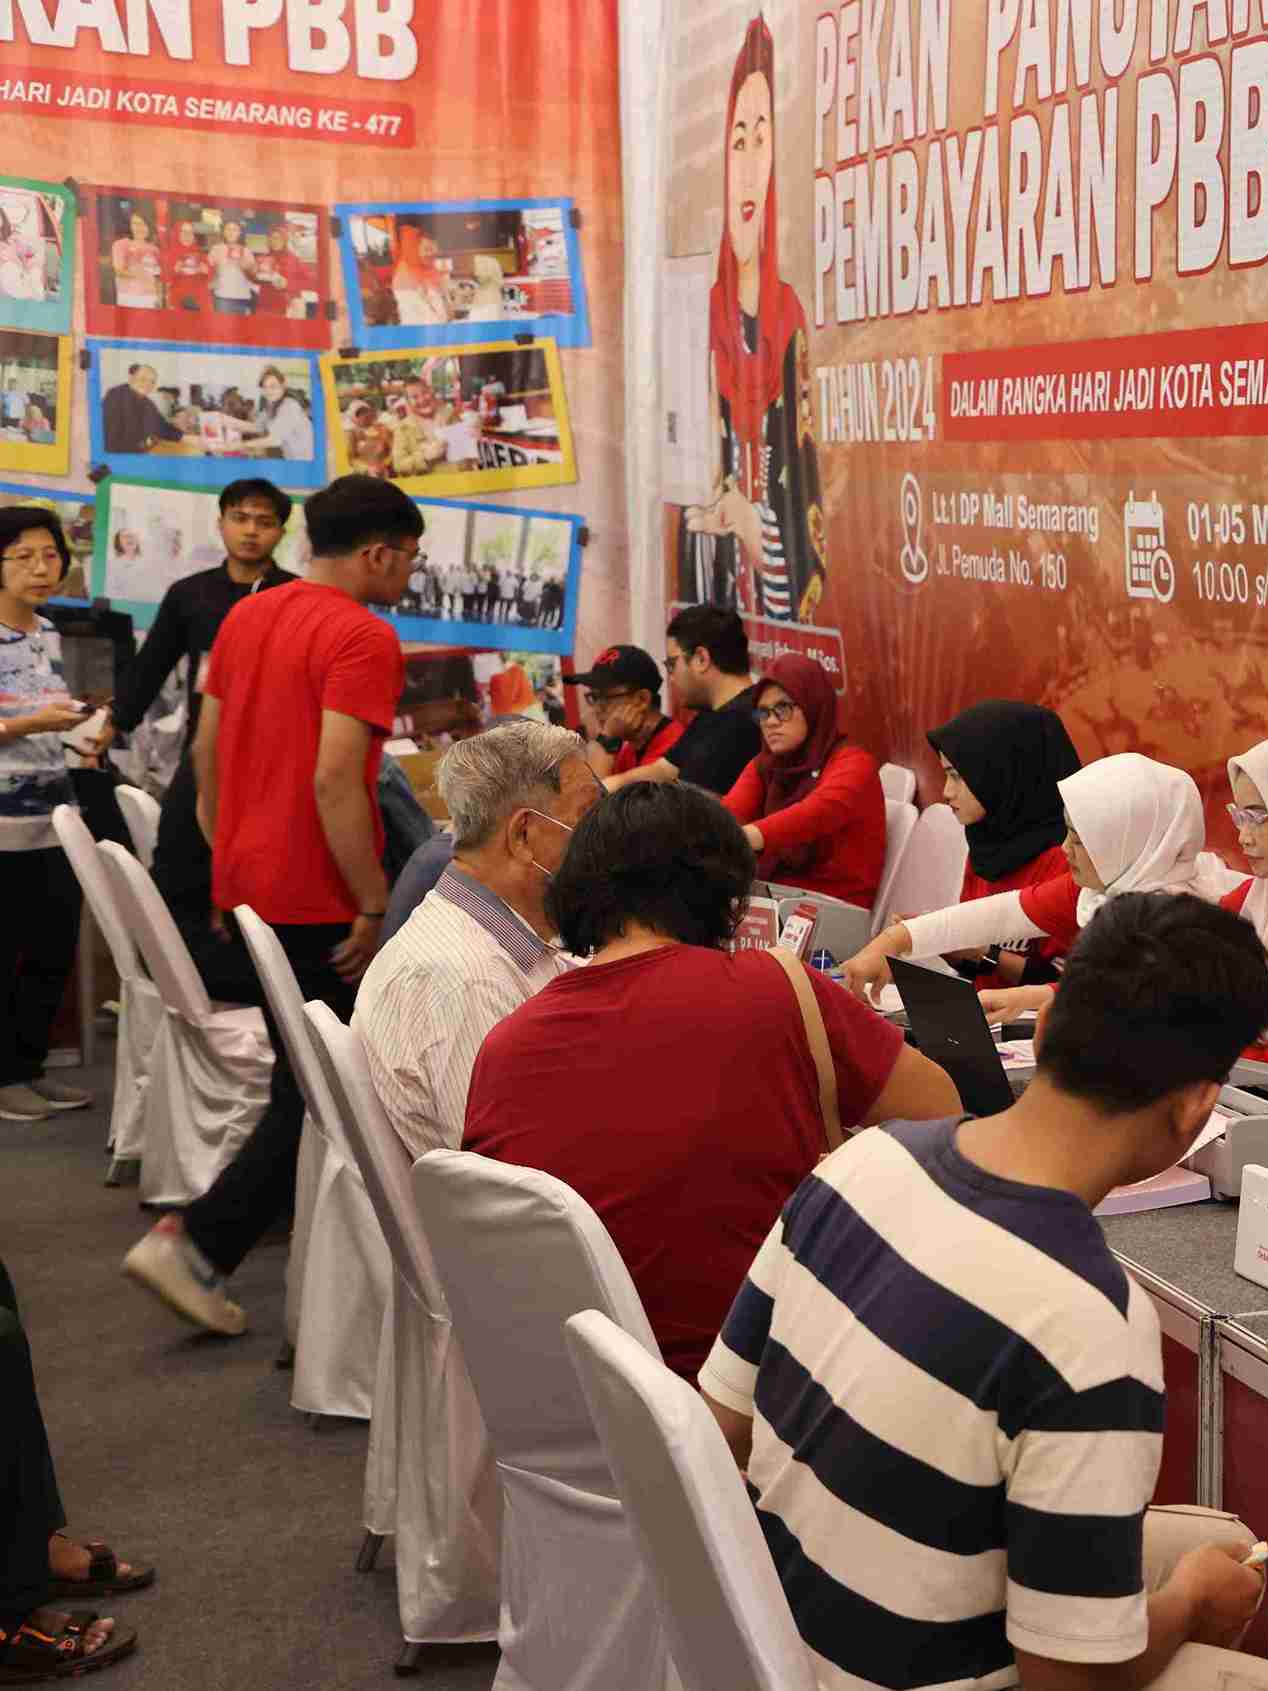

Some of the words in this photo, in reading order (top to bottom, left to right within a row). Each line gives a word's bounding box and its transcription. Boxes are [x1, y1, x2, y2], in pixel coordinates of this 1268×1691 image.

[221, 0, 419, 81] PBB
[57, 86, 111, 111] JADI
[116, 90, 178, 117] KOTA
[184, 96, 312, 129] SEMARANG
[317, 109, 350, 132] KE
[366, 113, 402, 137] 477
[814, 88, 1117, 328] PEMBAYARAN
[816, 362, 879, 442] TAHUN
[880, 355, 937, 442] 2024
[950, 379, 1000, 418] DALAM
[1001, 374, 1067, 416] RANGKA
[1069, 370, 1112, 413] HARI
[1114, 366, 1156, 411] JADI
[1159, 362, 1214, 410] KOTA
[959, 491, 980, 526] DP
[983, 490, 1014, 529] Mall
[1017, 494, 1100, 544] Semarang
[1187, 502, 1247, 544] 01-05
[952, 544, 1006, 583] Pemuda
[1009, 548, 1034, 586] No.
[1039, 553, 1068, 591] 150
[1192, 559, 1249, 605] 10.00
